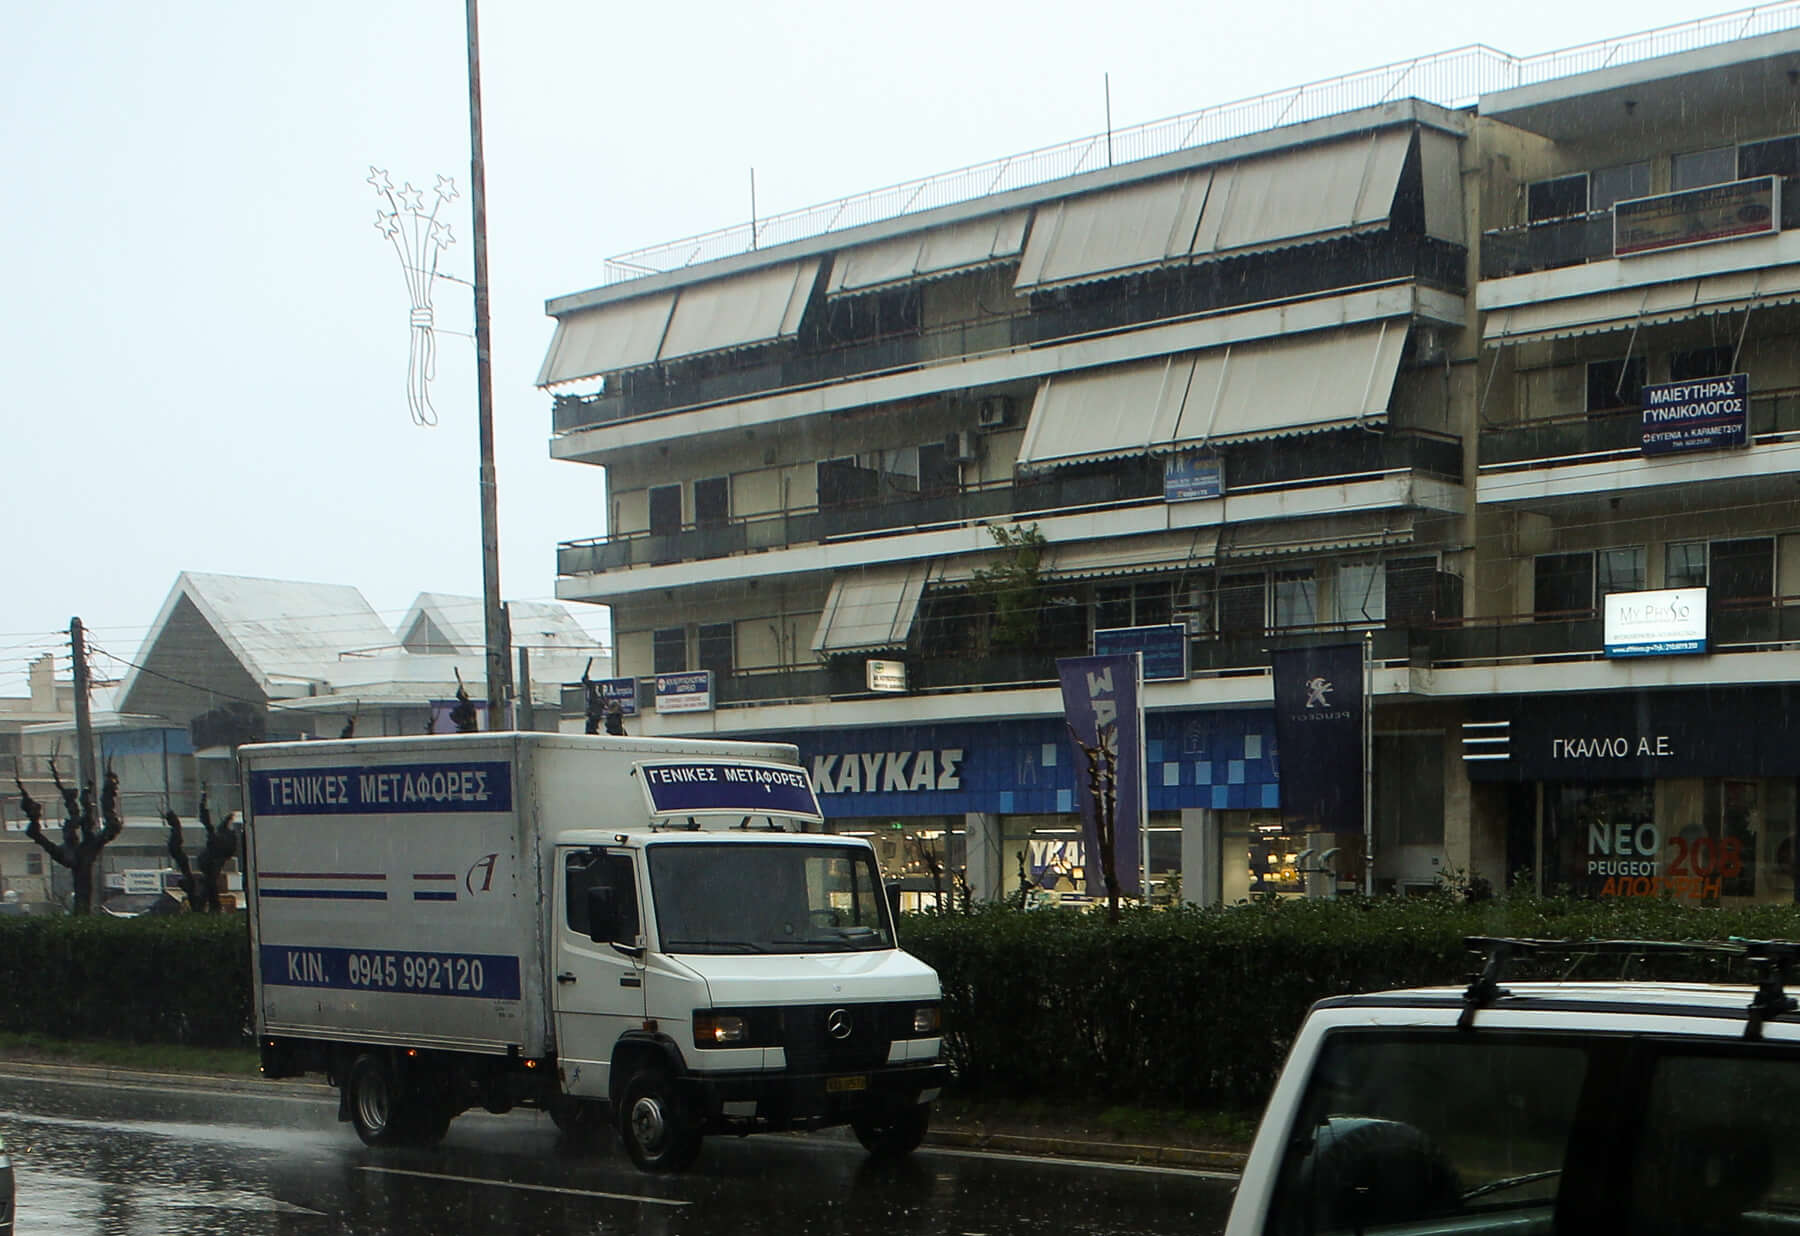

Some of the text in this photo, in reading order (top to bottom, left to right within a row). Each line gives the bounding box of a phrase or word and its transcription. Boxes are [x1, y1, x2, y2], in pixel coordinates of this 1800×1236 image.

[1650, 380, 1735, 404] ΜΑΙΕΥΤΗΡΑΣ
[1642, 398, 1743, 423] ΓΥΝΑΙΚΟΛΟΓΟΣ
[1553, 736, 1674, 758] ΓΚΑΛΛΟ Α.Ε.
[649, 768, 806, 789] ΓΕΝΙΚΕΣ ΜΕΤΑΦΟΡΕΣ
[813, 748, 964, 794] ΚΑΥΚΑΣ
[269, 771, 488, 806] ΓΕΝΙΚΕΣ ΜΕΤΑΦΟΡΕΣ
[1588, 823, 1660, 856] ΝΕΟ
[1588, 860, 1660, 876] PEUGEOT
[1667, 836, 1743, 878] 208
[287, 951, 329, 983] ΚΙΝ.
[403, 956, 484, 991] 992120
